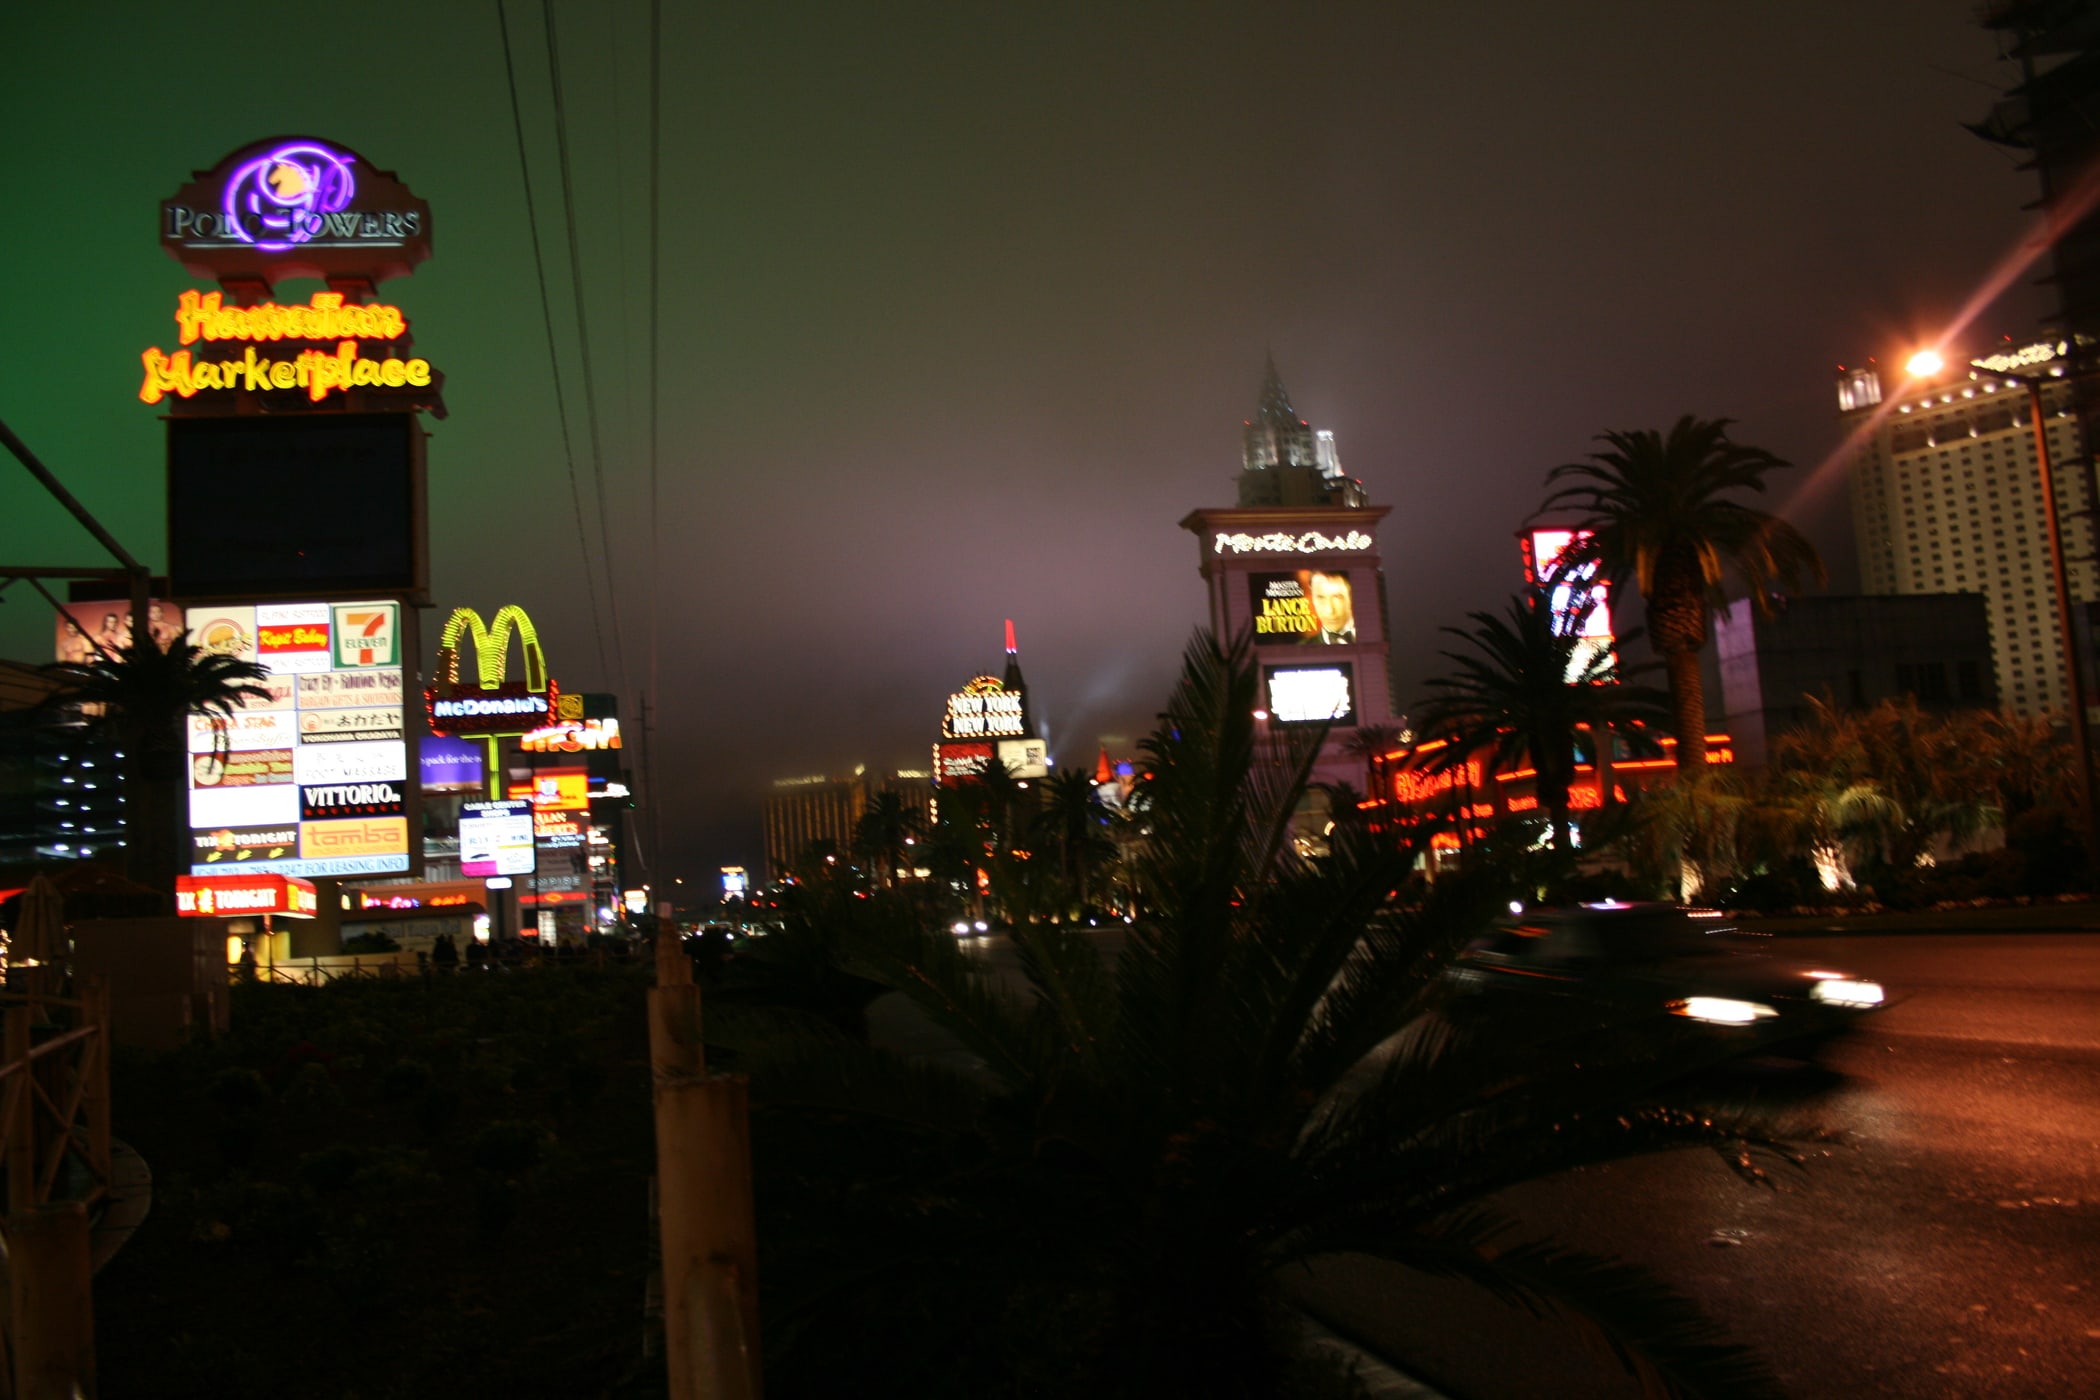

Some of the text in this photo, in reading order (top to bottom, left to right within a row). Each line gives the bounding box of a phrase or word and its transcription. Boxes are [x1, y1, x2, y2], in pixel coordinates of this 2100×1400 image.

[139, 340, 431, 404] Marketplace
[1262, 599, 1311, 616] LANCE
[1255, 615, 1318, 634] BURTON
[434, 697, 548, 717] McDonald's
[952, 695, 1022, 714] NEW YORK
[953, 715, 1024, 734] NEW YORK
[304, 784, 393, 807] VITTORIO
[235, 831, 296, 847] TONIGHT
[307, 825, 400, 846] tamba
[215, 889, 277, 909] TONIGHT
